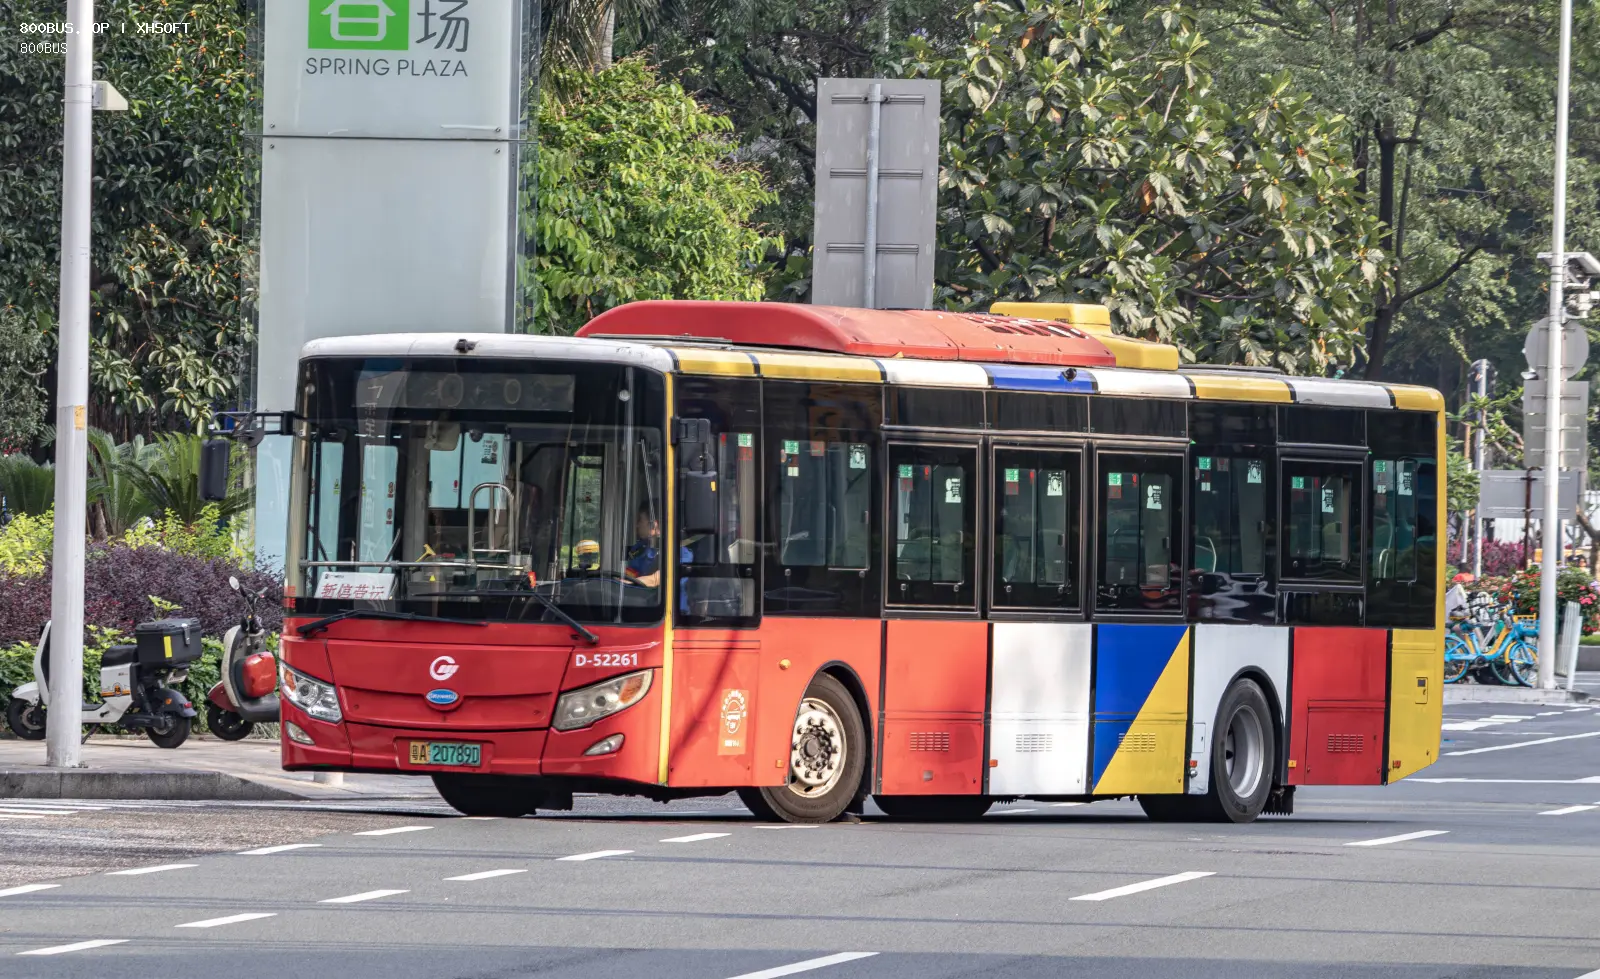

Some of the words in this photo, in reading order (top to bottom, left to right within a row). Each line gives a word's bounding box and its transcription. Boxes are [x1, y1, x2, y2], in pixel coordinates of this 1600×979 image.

[305, 57, 390, 76] SPRING
[397, 59, 468, 77] PLAZA
[575, 653, 638, 667] D-52261
